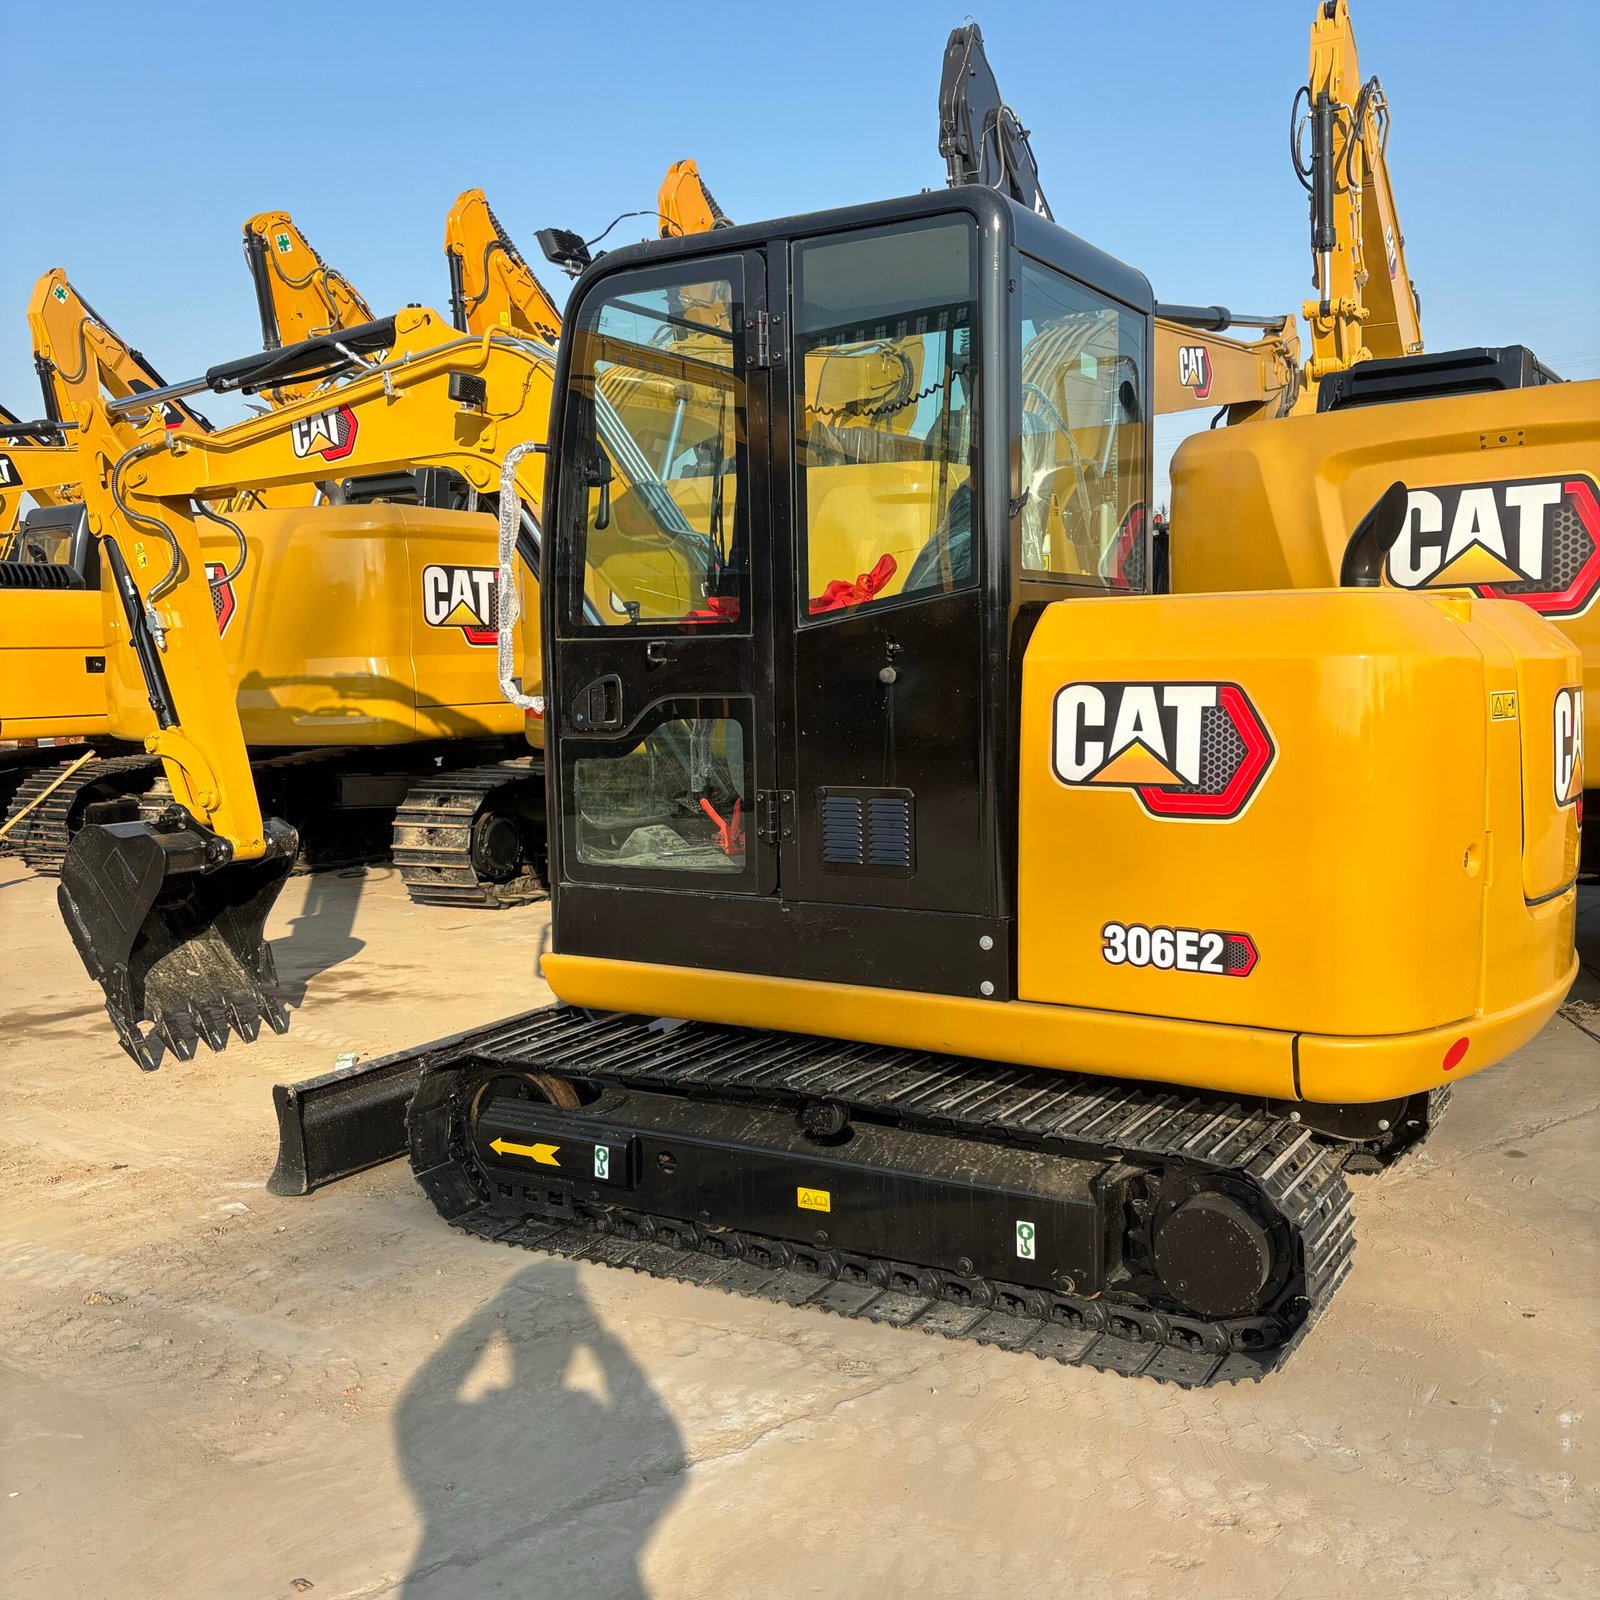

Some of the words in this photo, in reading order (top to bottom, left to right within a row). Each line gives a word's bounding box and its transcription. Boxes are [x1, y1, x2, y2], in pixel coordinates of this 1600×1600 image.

[1179, 347, 1203, 386] CAT
[292, 406, 340, 457] CAT
[1389, 483, 1561, 587] CAT
[424, 566, 494, 626] CAT
[1056, 685, 1217, 785] CAT
[1554, 690, 1584, 802] CA
[1104, 924, 1224, 973] 306E2
